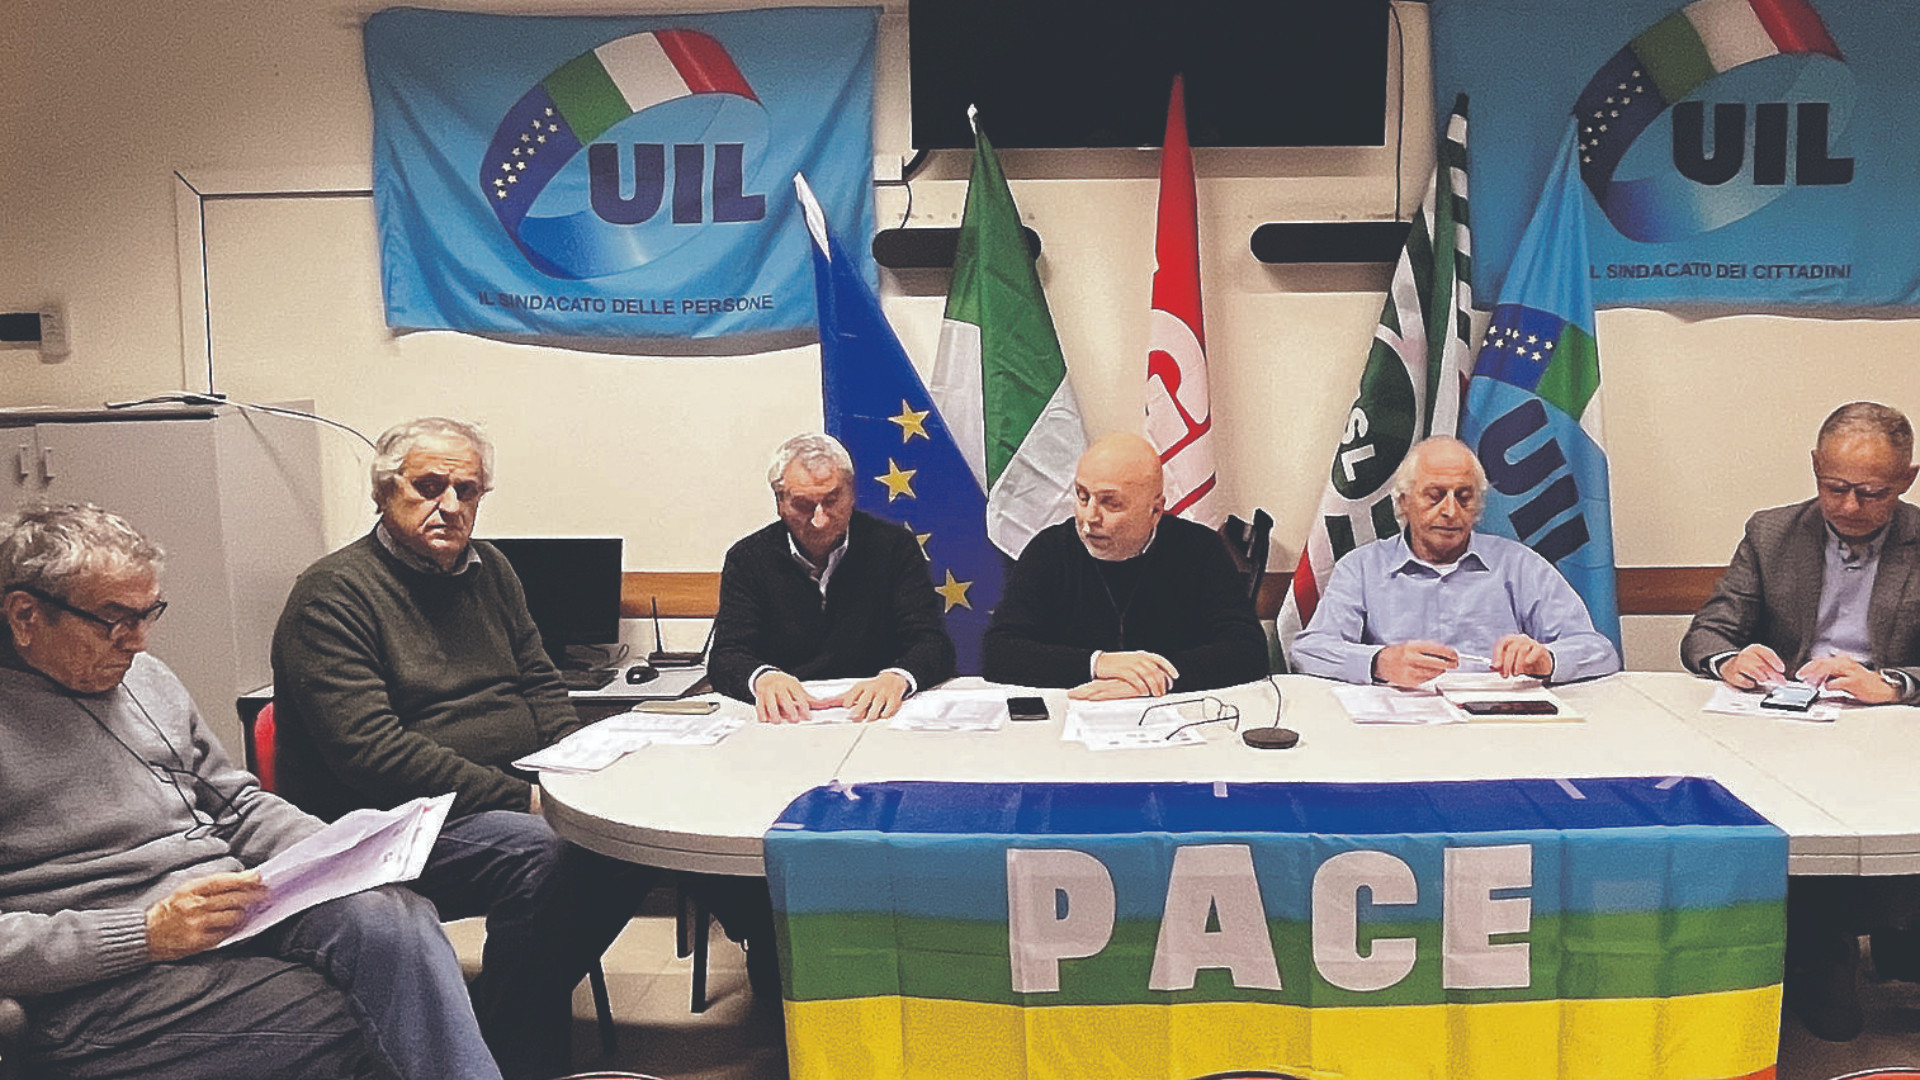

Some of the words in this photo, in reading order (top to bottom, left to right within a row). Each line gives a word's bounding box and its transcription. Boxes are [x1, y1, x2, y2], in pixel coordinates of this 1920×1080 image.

[588, 143, 766, 225] UIL
[1671, 102, 1854, 186] UIL
[478, 291, 495, 306] IL
[498, 292, 606, 313] SINDACATO
[612, 298, 676, 315] DELLE
[681, 295, 774, 315] PERSONE
[1590, 264, 1601, 279] L
[1606, 262, 1712, 279] SINDACATO
[1716, 264, 1747, 279] DEI
[1753, 264, 1851, 279] CITTADINI
[1006, 843, 1533, 993] PACE
